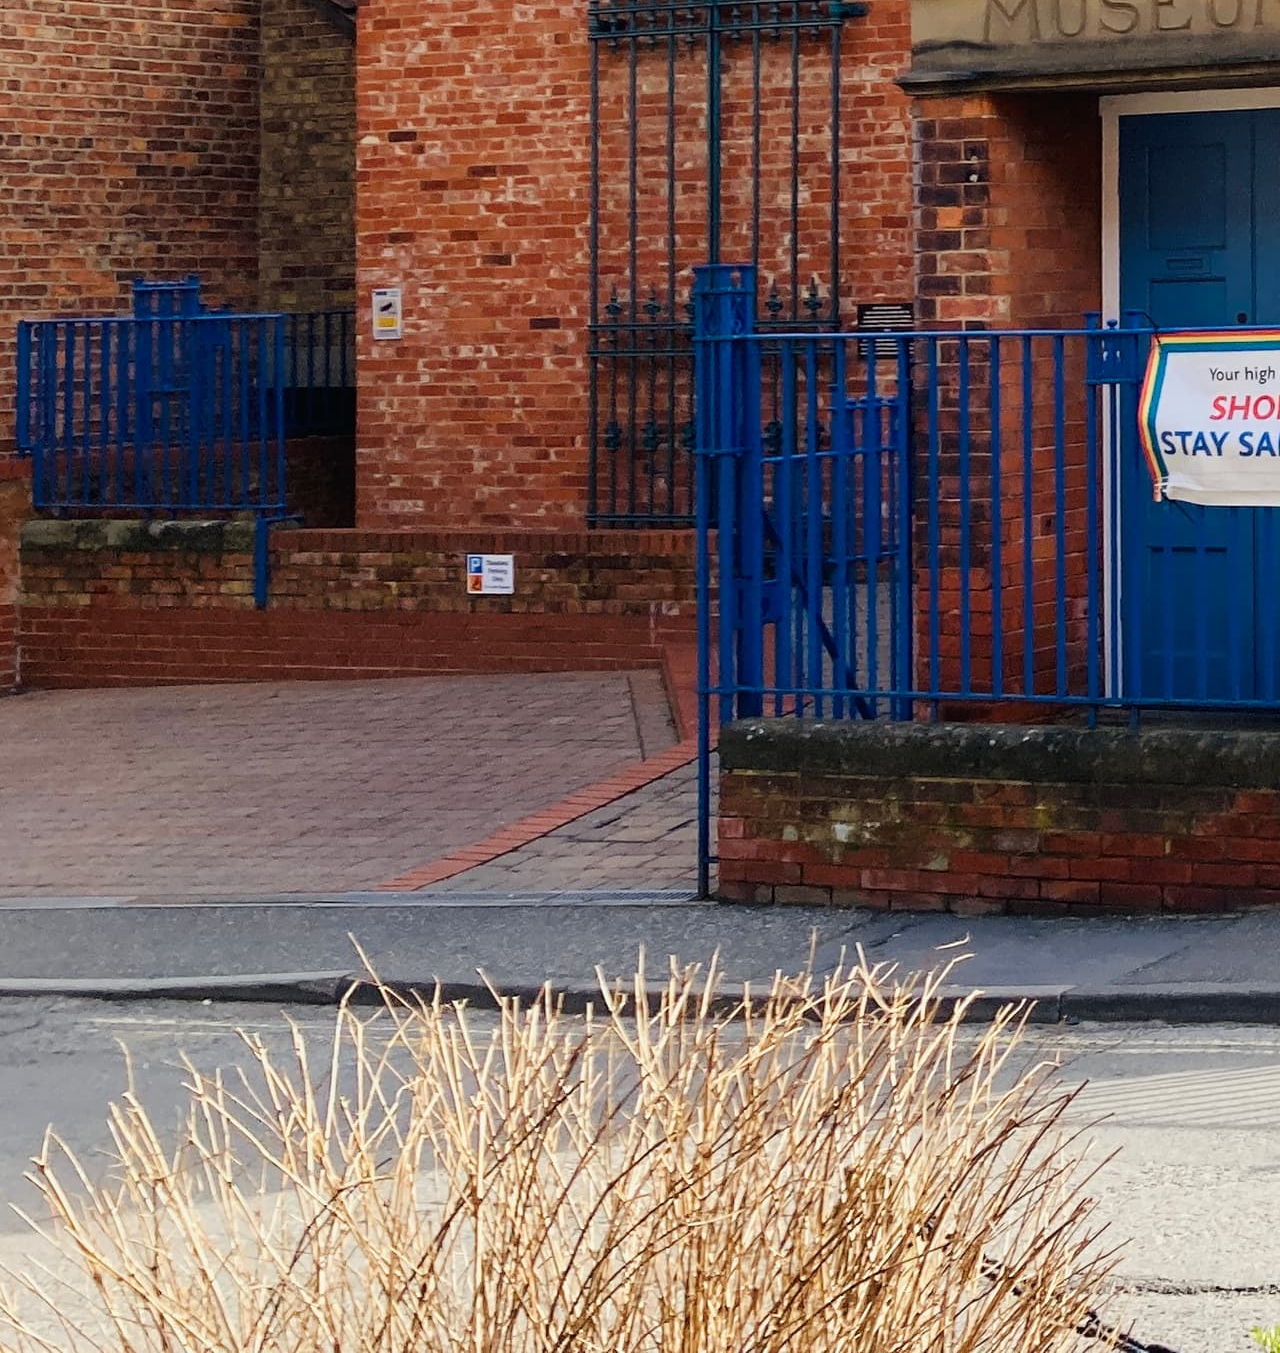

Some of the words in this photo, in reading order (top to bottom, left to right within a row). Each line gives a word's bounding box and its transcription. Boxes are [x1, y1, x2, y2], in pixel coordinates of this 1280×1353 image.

[1208, 367, 1240, 381] Your
[1244, 365, 1276, 385] high
[1160, 430, 1230, 457] STAY
